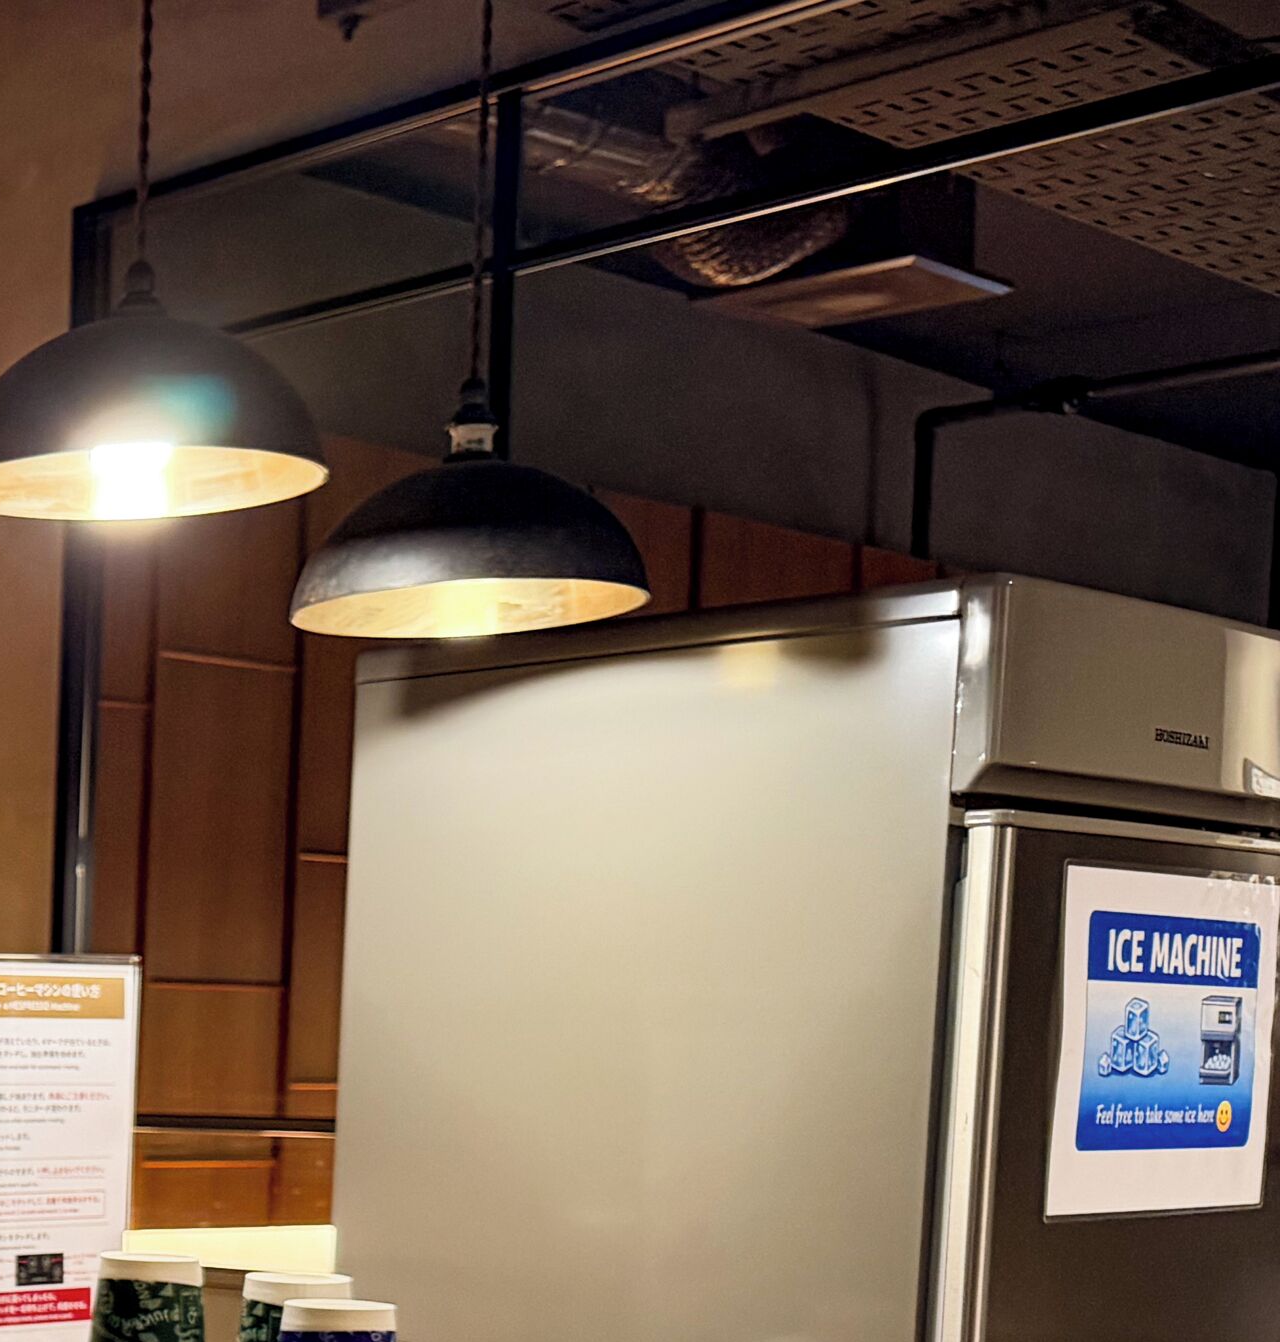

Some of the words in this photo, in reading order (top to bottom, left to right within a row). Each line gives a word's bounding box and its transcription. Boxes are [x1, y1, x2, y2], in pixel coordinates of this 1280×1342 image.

[1155, 728, 1210, 750] HOSHIZAKI
[1107, 928, 1143, 974] ICE
[1150, 931, 1243, 979] MACHINE
[1096, 1103, 1113, 1125] Feel
[1114, 1103, 1132, 1128] free
[1133, 1105, 1143, 1124] to
[1145, 1103, 1163, 1125] take
[1164, 1107, 1184, 1125] some
[1185, 1105, 1196, 1124] ice
[1197, 1103, 1215, 1124] here
